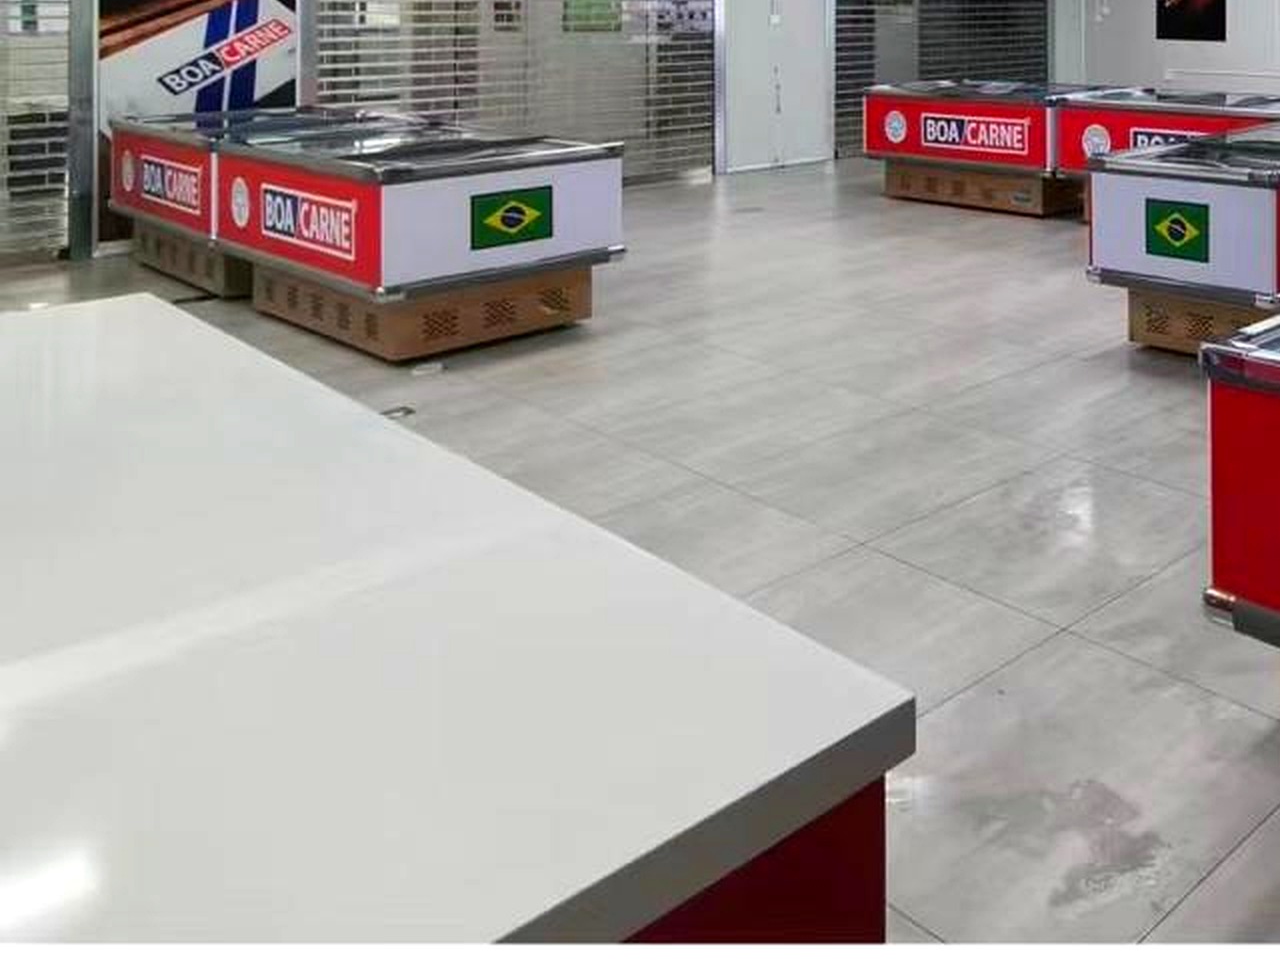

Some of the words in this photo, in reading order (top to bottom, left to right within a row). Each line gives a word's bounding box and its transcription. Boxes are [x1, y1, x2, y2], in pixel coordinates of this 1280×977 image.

[161, 58, 222, 92] BOA
[219, 20, 291, 64] CARNE
[925, 118, 960, 144] BOA
[966, 122, 1024, 149] CARNE
[143, 161, 164, 195] BOA
[164, 169, 199, 206] CARNE
[264, 194, 295, 235] BOA
[300, 202, 351, 250] CARNE
